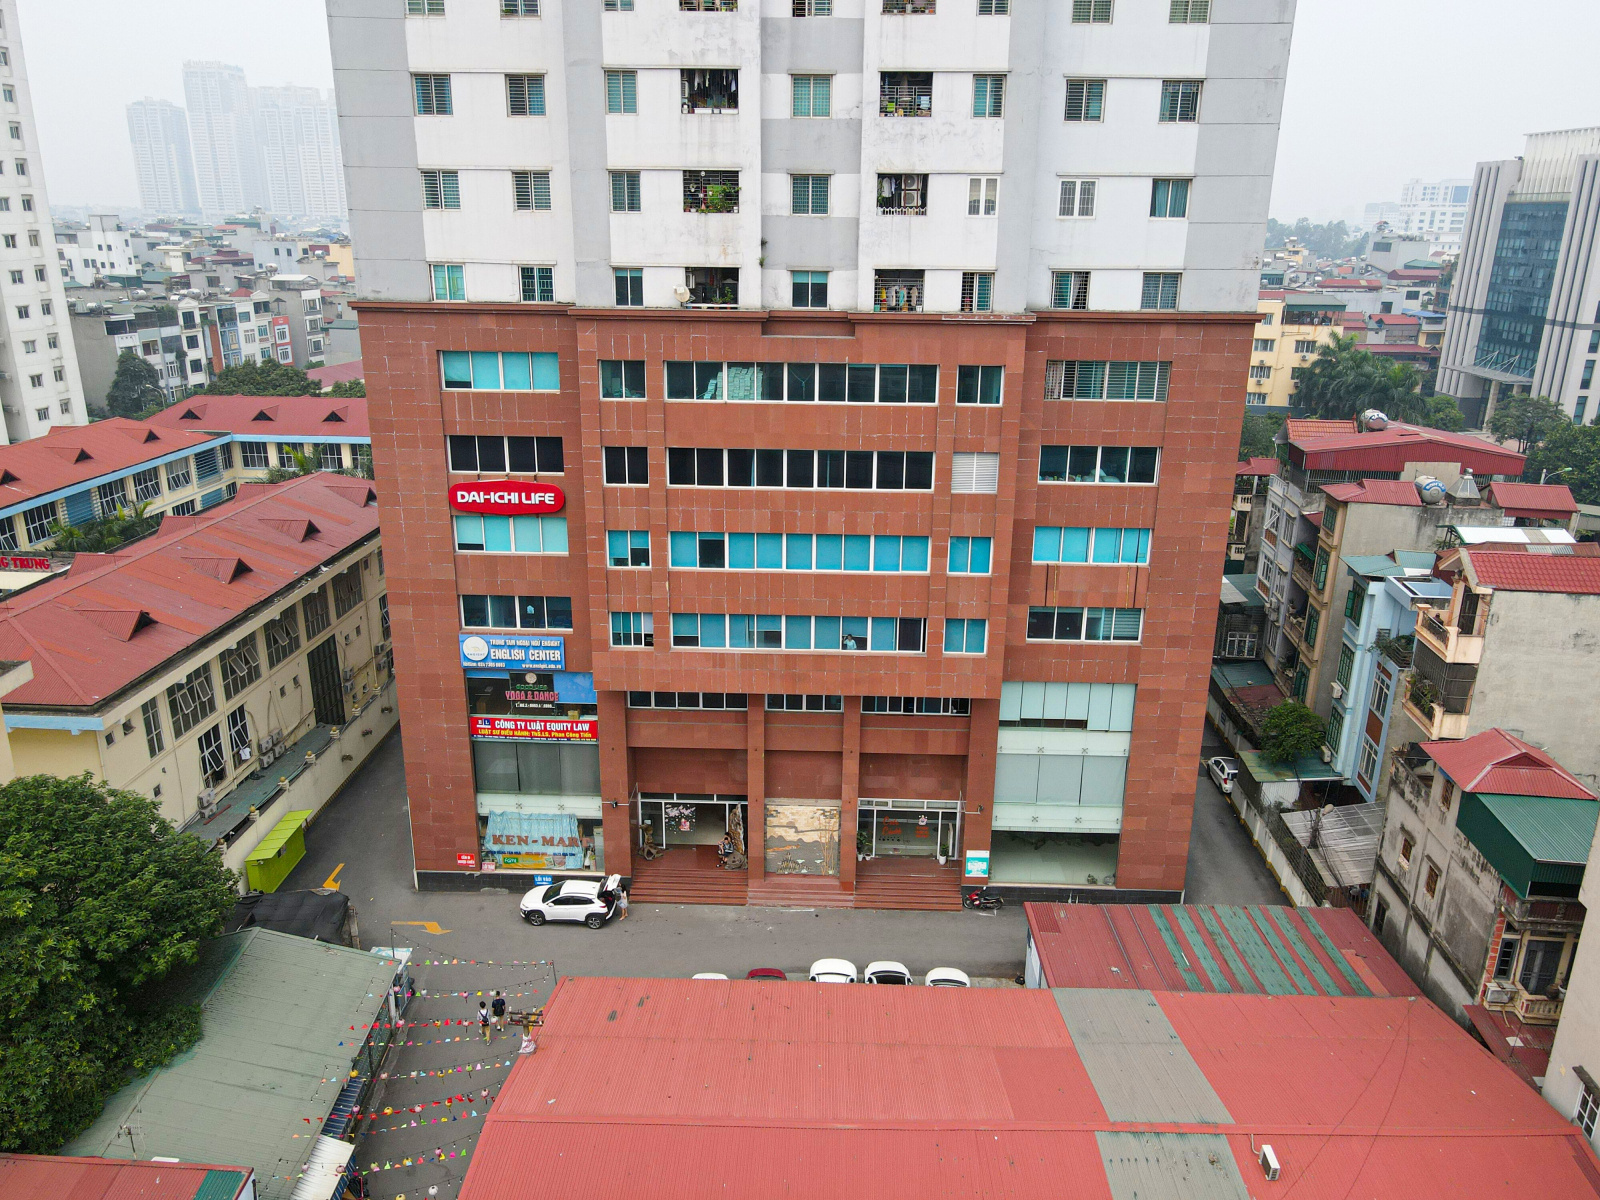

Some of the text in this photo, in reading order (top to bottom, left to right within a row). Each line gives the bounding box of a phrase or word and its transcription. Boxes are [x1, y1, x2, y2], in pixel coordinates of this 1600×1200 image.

[457, 491, 555, 505] DAI-ICHI LIFE
[0, 556, 50, 569] G TRUNG
[490, 648, 561, 661] ENGLISH CENTER
[505, 691, 559, 701] YOGA & DANCE
[495, 719, 590, 731] CÔNG TY LUẬT EQUITY LAW
[492, 834, 529, 846] KEN
